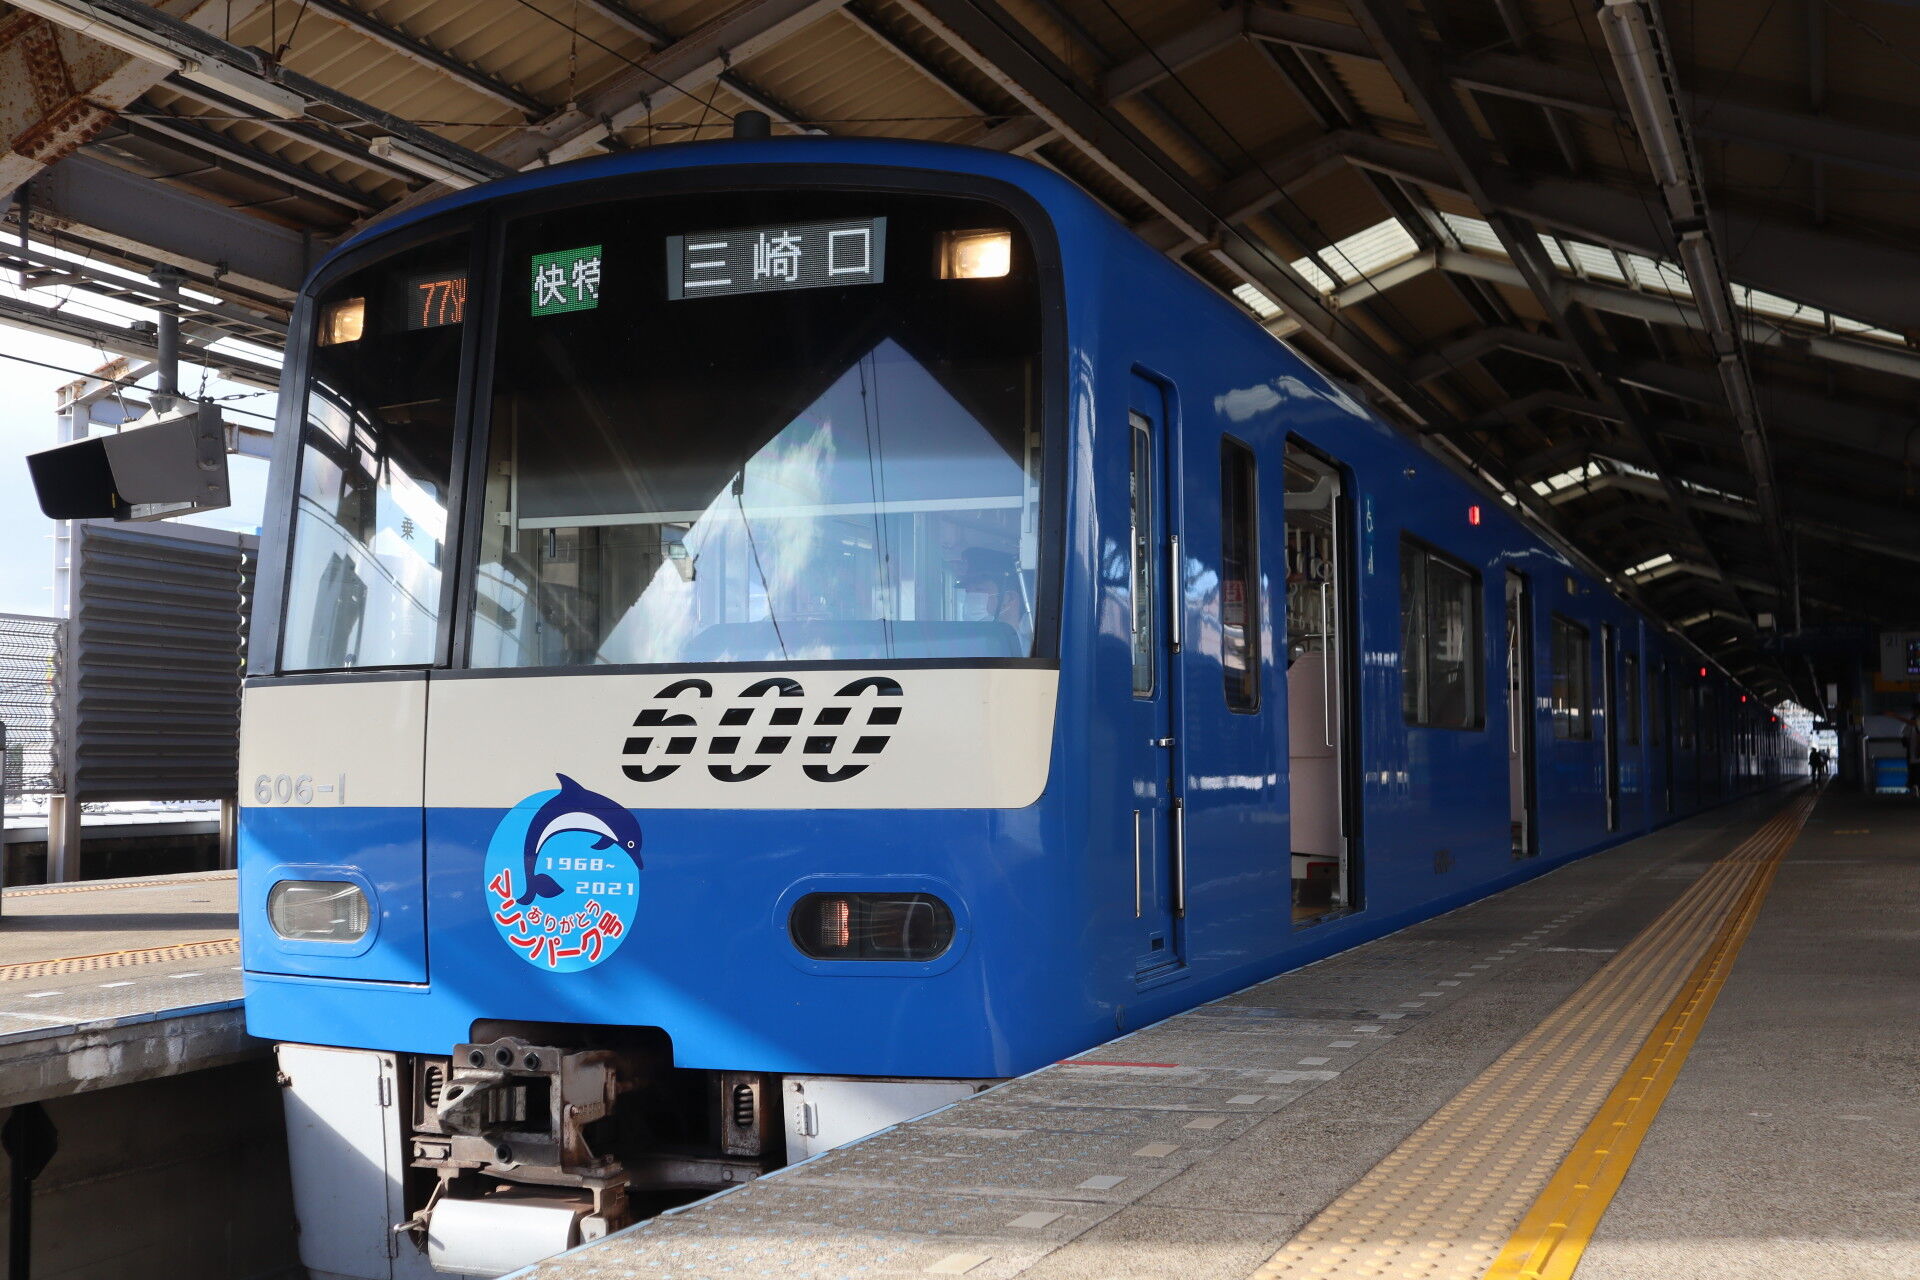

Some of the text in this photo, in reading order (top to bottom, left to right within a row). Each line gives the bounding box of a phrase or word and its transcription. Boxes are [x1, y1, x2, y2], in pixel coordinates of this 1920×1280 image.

[685, 228, 871, 287] 三崎口
[534, 258, 602, 306] 快特
[622, 676, 904, 783] 600
[254, 773, 346, 805] 606-1
[575, 881, 634, 896] 2021
[489, 868, 624, 967] マリンパーク号
[527, 899, 601, 934] ありがとう
